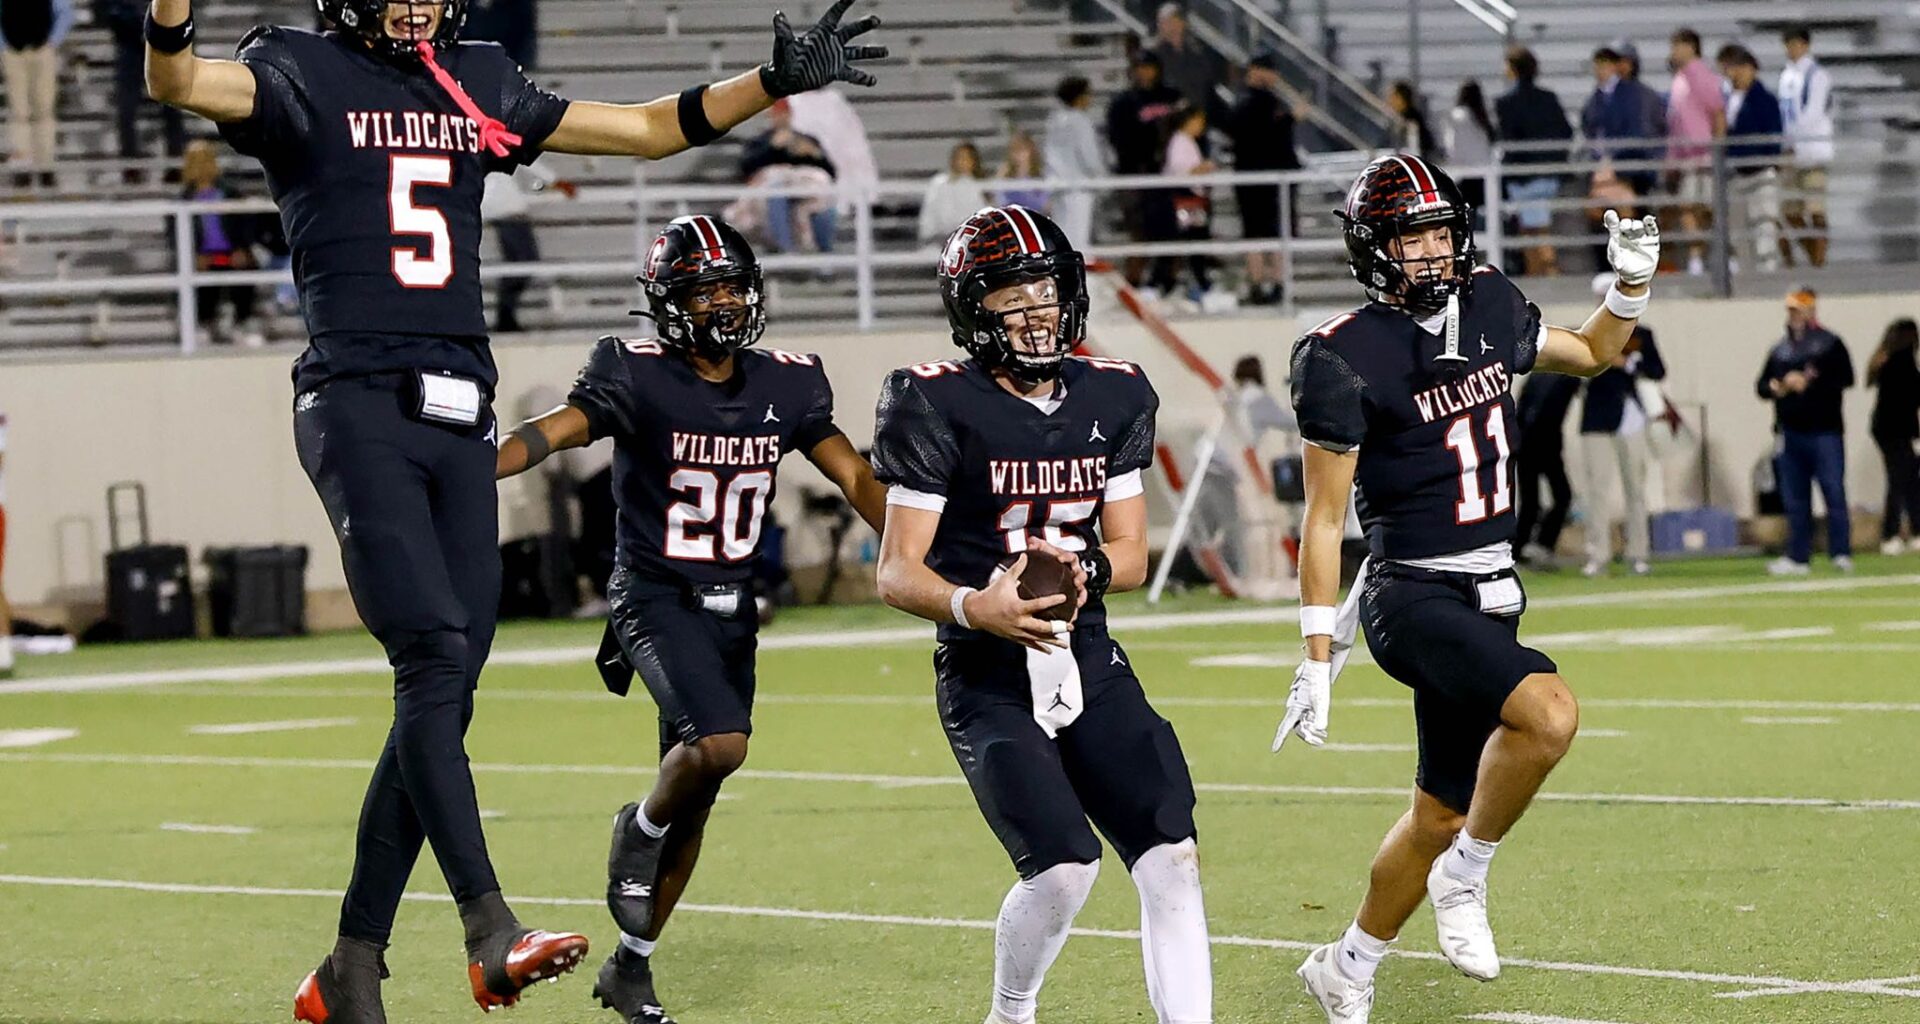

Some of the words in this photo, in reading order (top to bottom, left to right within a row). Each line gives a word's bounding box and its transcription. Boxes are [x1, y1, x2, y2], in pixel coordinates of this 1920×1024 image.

[346, 111, 479, 153] WILDCATS
[387, 153, 455, 288] 5
[1413, 360, 1511, 424] WILDCATS
[672, 431, 781, 466] WILDCATS
[989, 455, 1107, 495] WILDCATS
[1444, 402, 1511, 526] 11
[664, 466, 773, 562] 20
